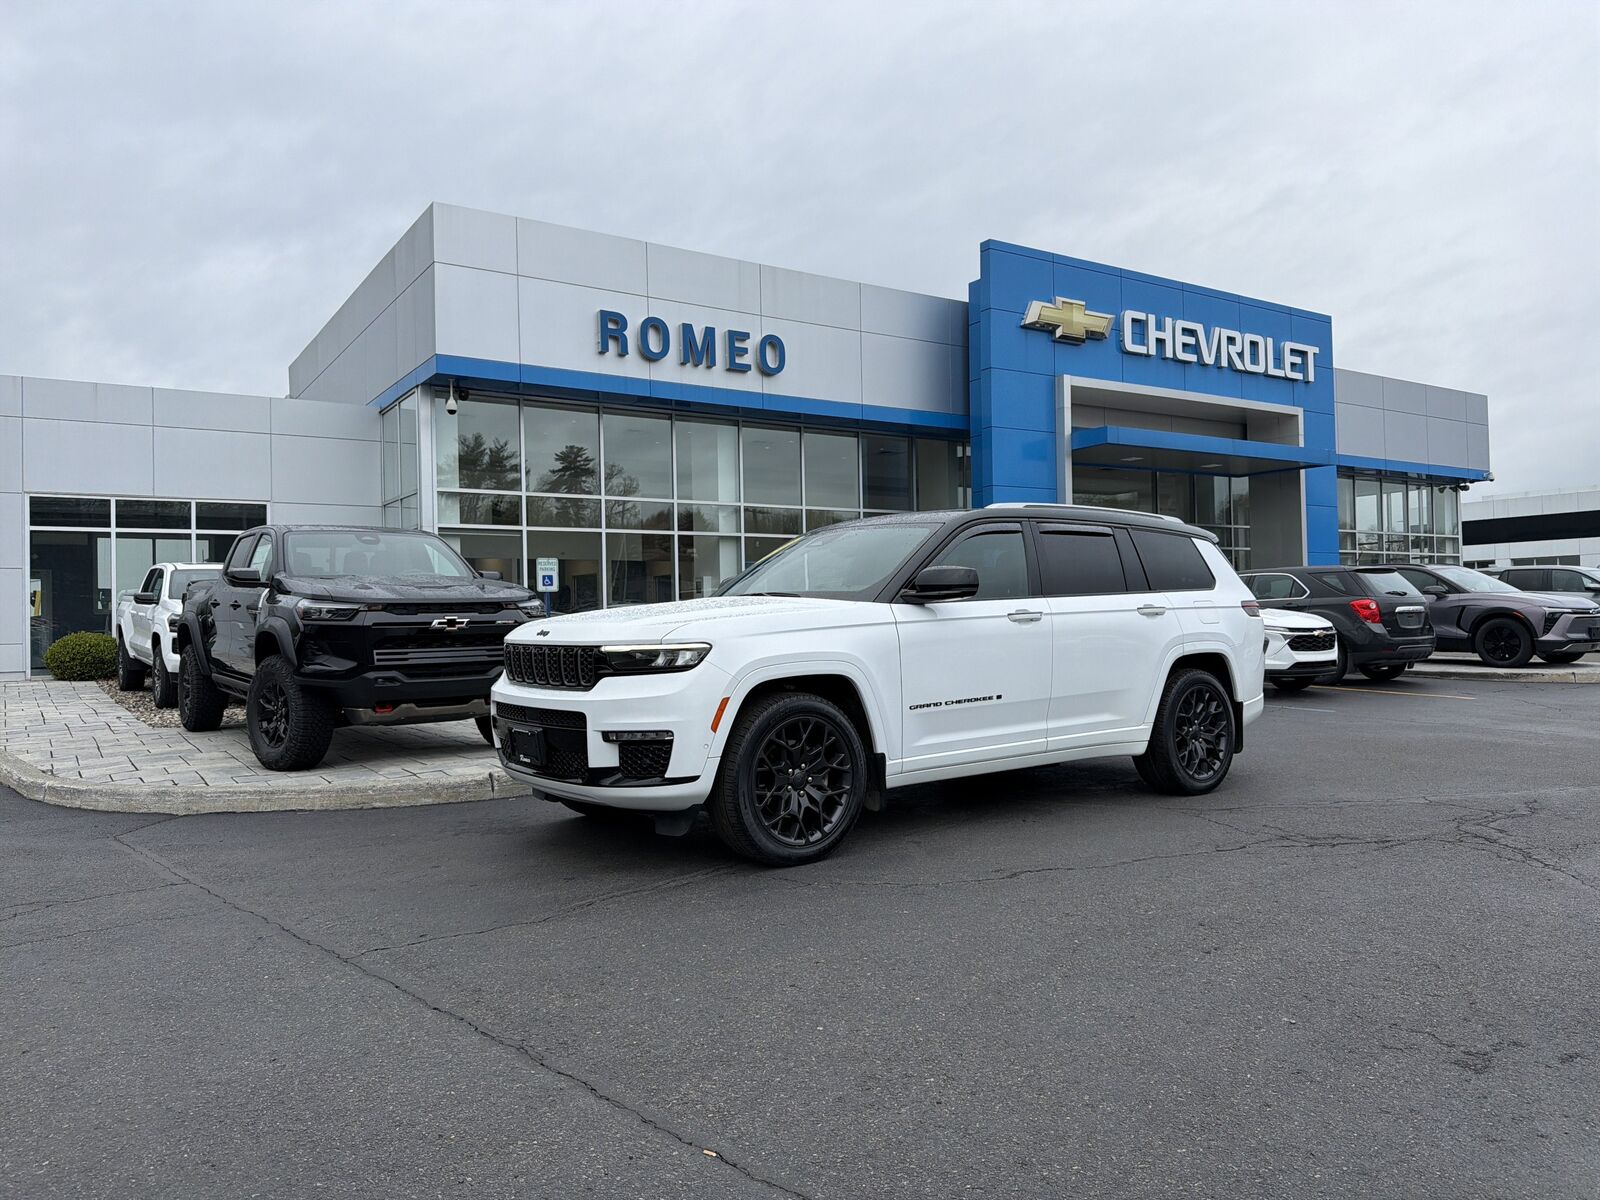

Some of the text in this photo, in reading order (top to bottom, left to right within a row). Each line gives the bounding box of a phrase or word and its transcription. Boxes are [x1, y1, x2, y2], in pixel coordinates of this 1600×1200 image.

[597, 309, 786, 376] ROMEO
[1121, 309, 1320, 383] CHEVROLET
[909, 701, 942, 710] GRAND
[945, 695, 994, 706] CHEROKEE
